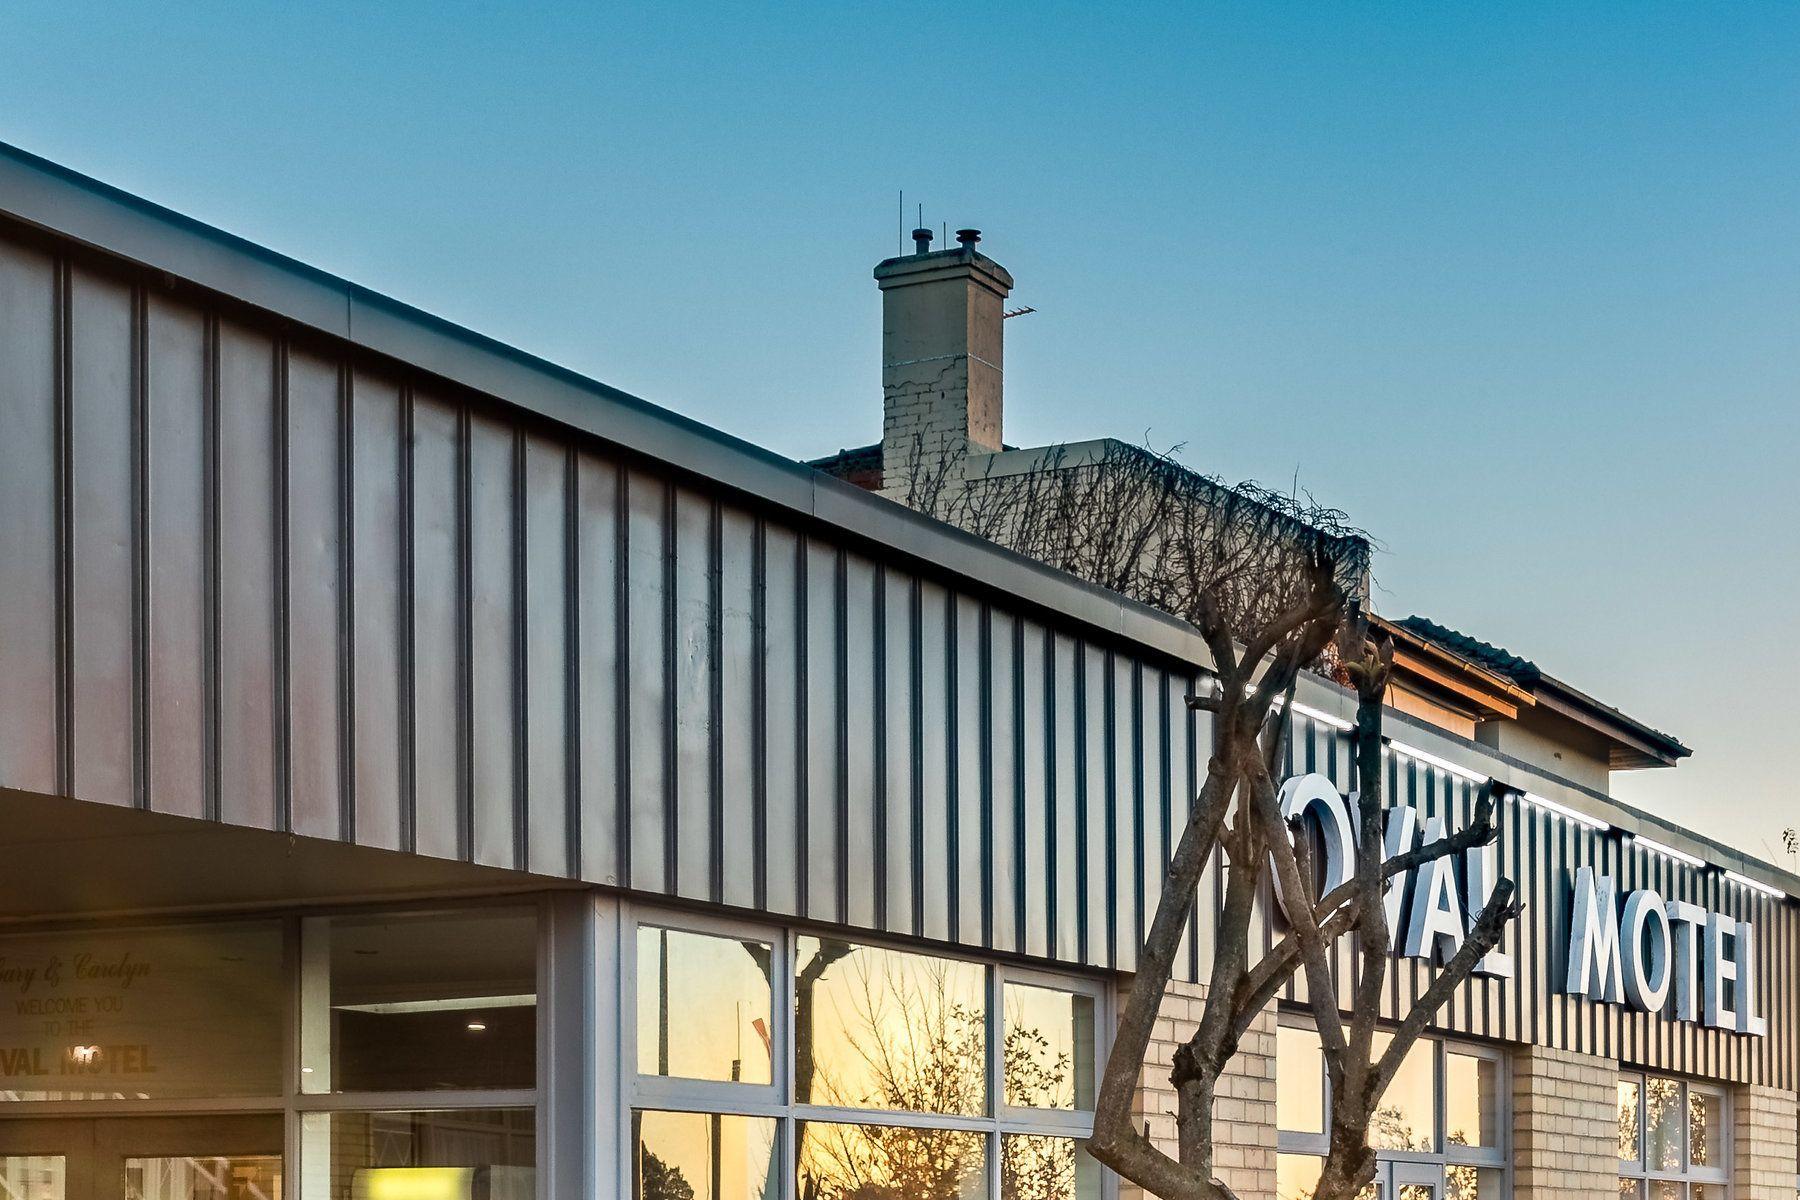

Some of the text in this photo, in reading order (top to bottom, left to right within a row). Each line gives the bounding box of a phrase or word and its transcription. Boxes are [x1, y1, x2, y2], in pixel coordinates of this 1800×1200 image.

[1567, 866, 1767, 1037] MOTEL
[73, 952, 152, 989] Carolyn
[16, 995, 124, 1015] WELCOME YOU
[43, 1019, 95, 1037] TO THE
